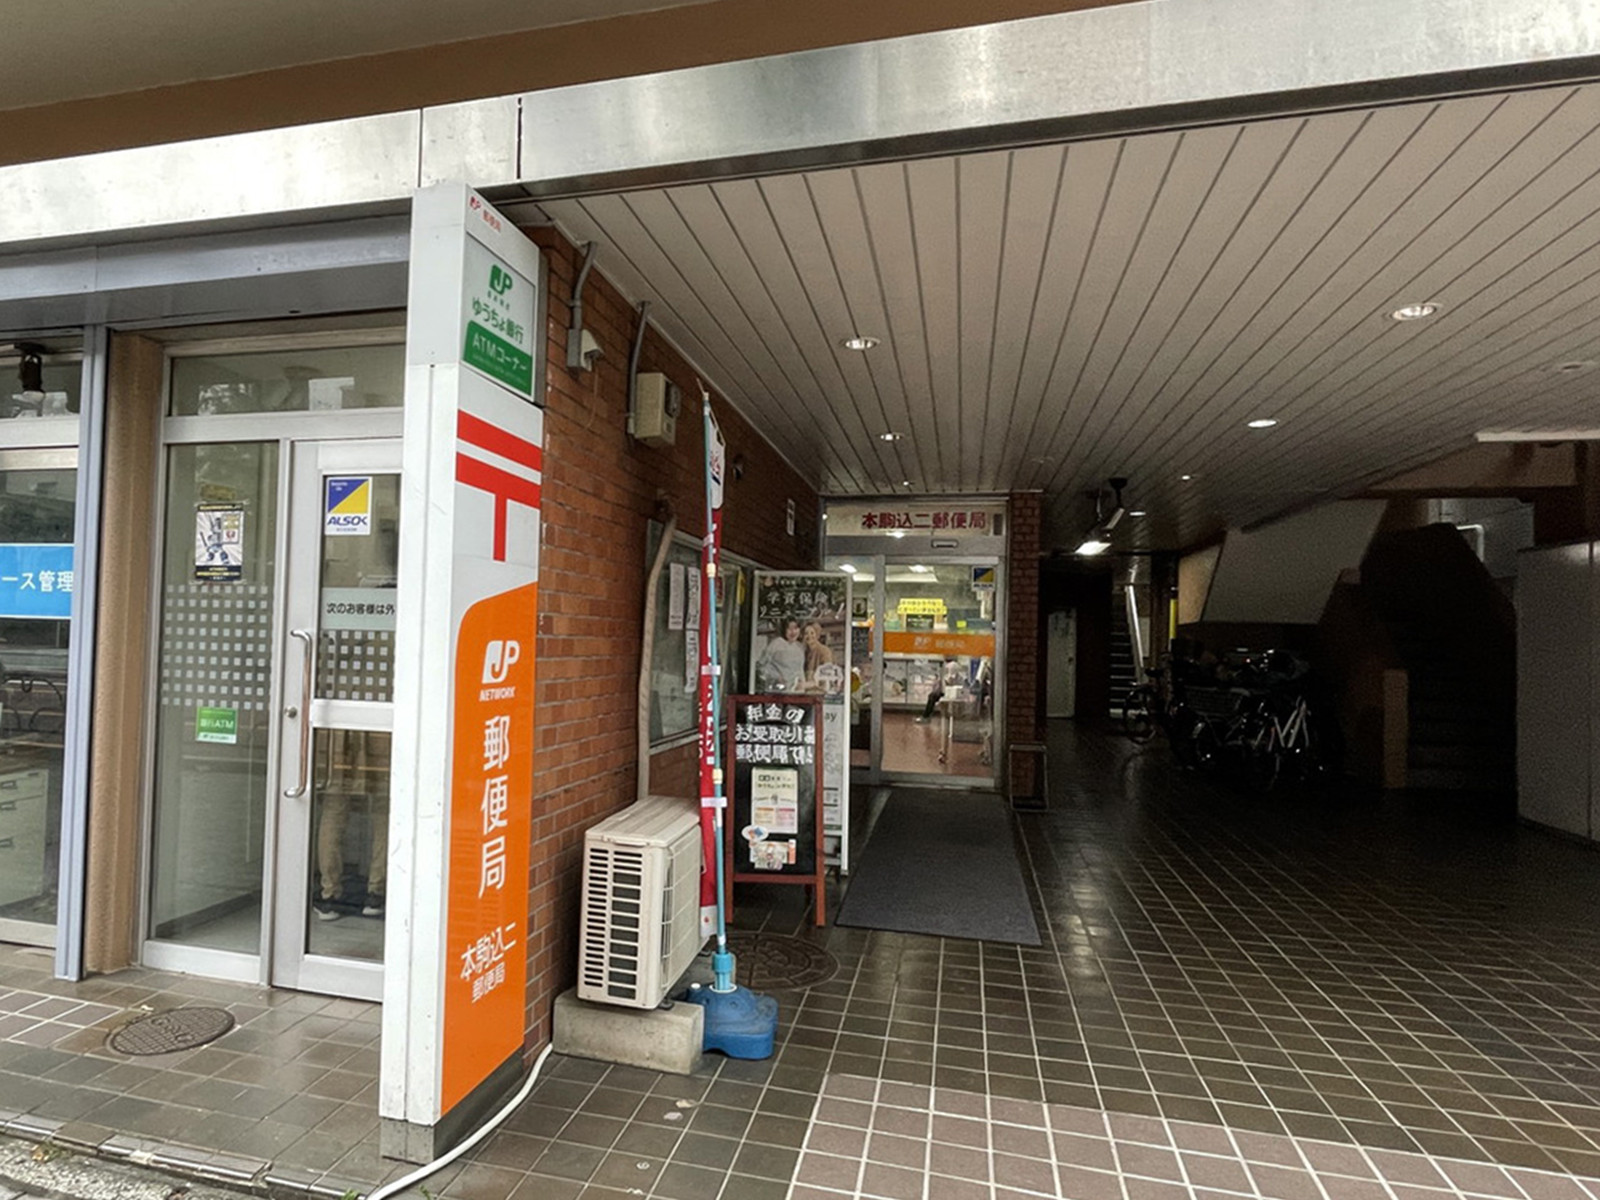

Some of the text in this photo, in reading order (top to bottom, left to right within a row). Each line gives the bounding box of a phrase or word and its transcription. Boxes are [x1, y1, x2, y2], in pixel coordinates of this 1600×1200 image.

[489, 264, 513, 296] JP
[472, 296, 524, 345] ゆうちょ銀行
[472, 331, 527, 371] ATMコーナー
[327, 516, 368, 526] ALSOK
[861, 511, 986, 529] 本駒込二郵便局
[1, 570, 74, 592] ース管理
[482, 640, 520, 684] JP
[479, 686, 516, 702] NETWORK
[478, 715, 511, 899] 郵便局
[460, 921, 517, 982] 本駒込二
[471, 961, 506, 1004] 郵便局
